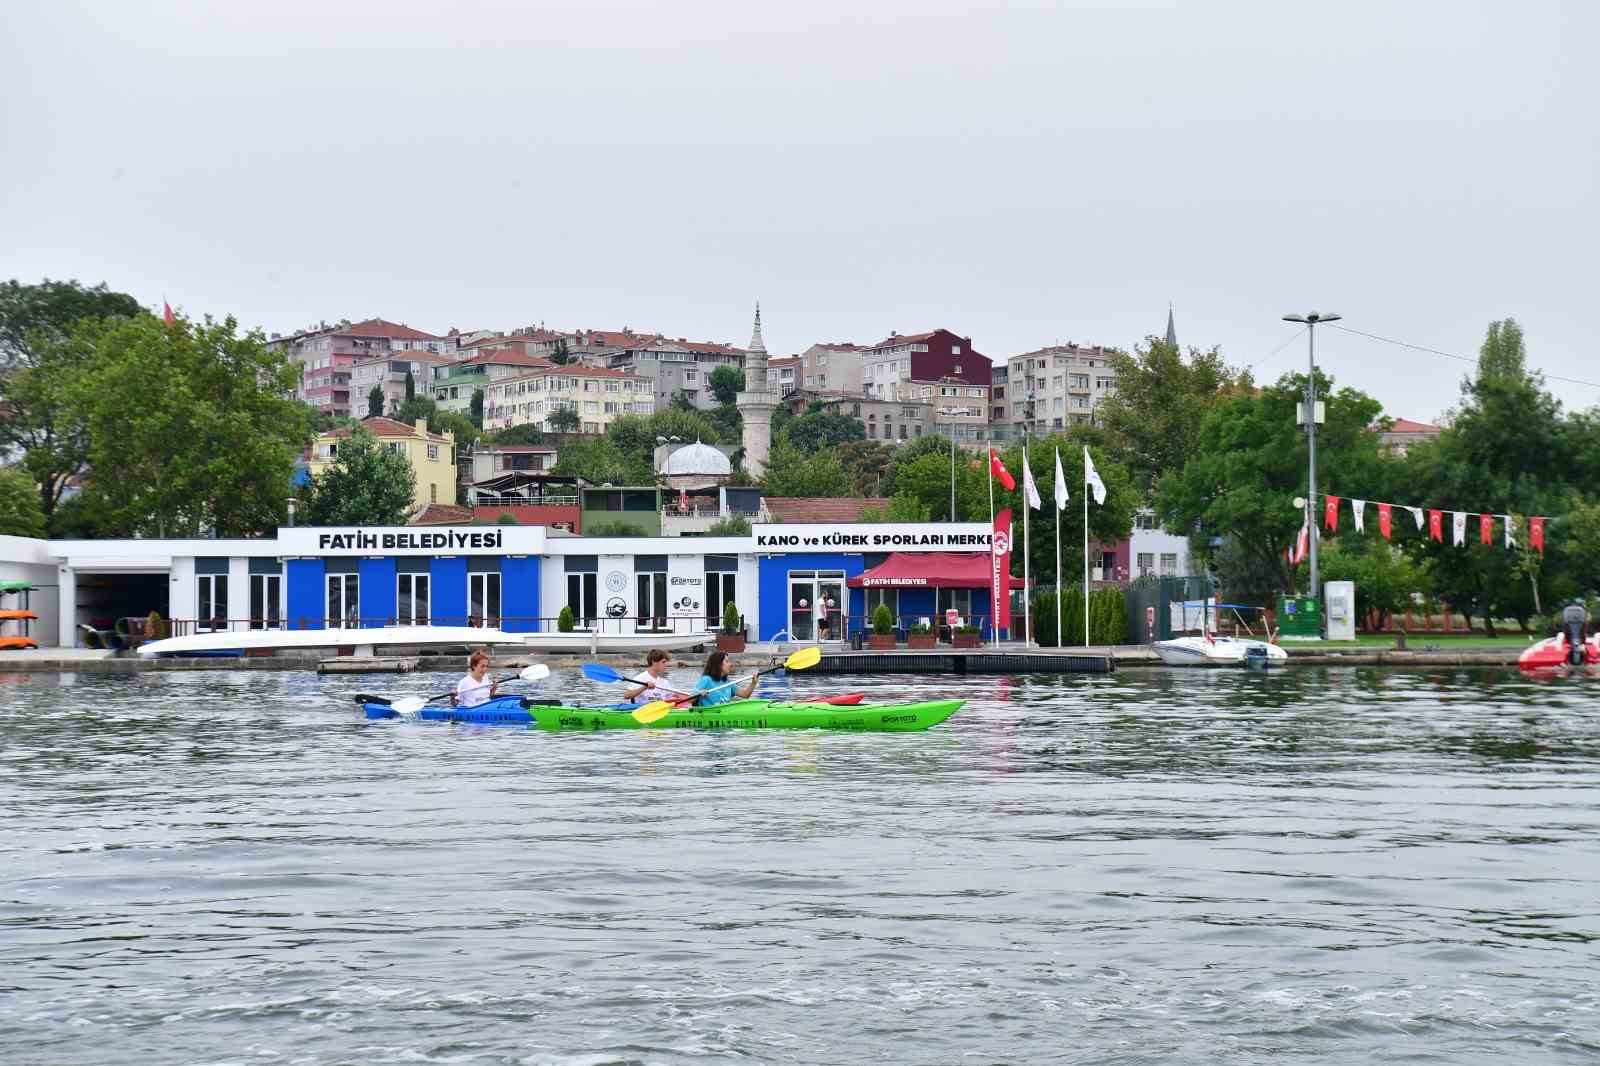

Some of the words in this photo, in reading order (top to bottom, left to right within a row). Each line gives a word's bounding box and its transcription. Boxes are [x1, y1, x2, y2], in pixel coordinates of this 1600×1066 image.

[319, 530, 377, 549] FATİH
[382, 529, 502, 548] BELEDİYESİ
[757, 535, 799, 546] KANO
[803, 537, 819, 546] ve
[823, 532, 868, 545] KÜREK
[873, 534, 943, 545] SPORLARI
[947, 534, 993, 545] MERKE
